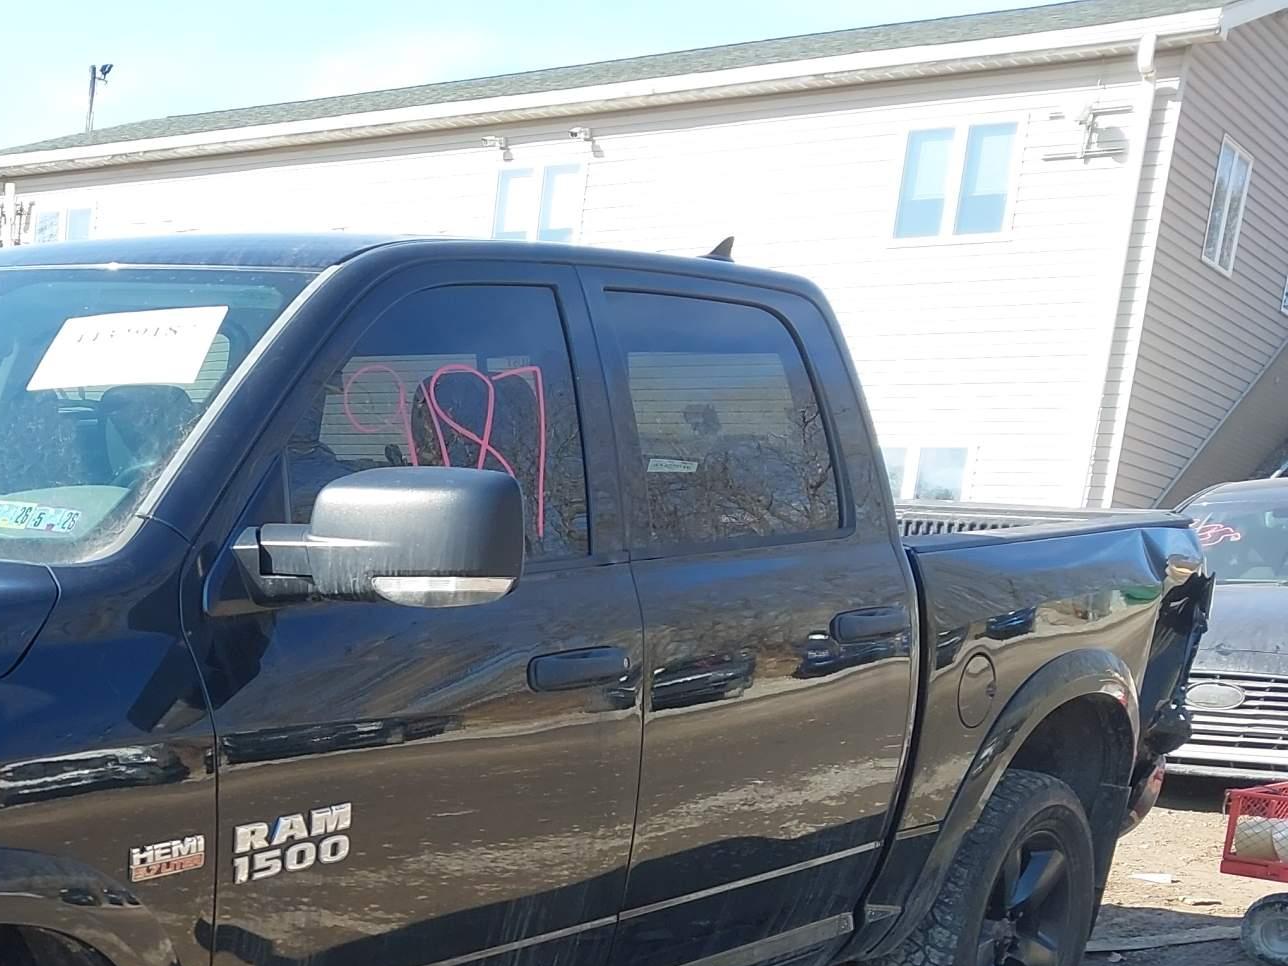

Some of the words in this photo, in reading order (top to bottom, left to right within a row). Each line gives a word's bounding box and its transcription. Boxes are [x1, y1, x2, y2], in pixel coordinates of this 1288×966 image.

[130, 834, 205, 866] HEMI
[234, 802, 352, 854] RAM
[233, 834, 350, 885] 1500
